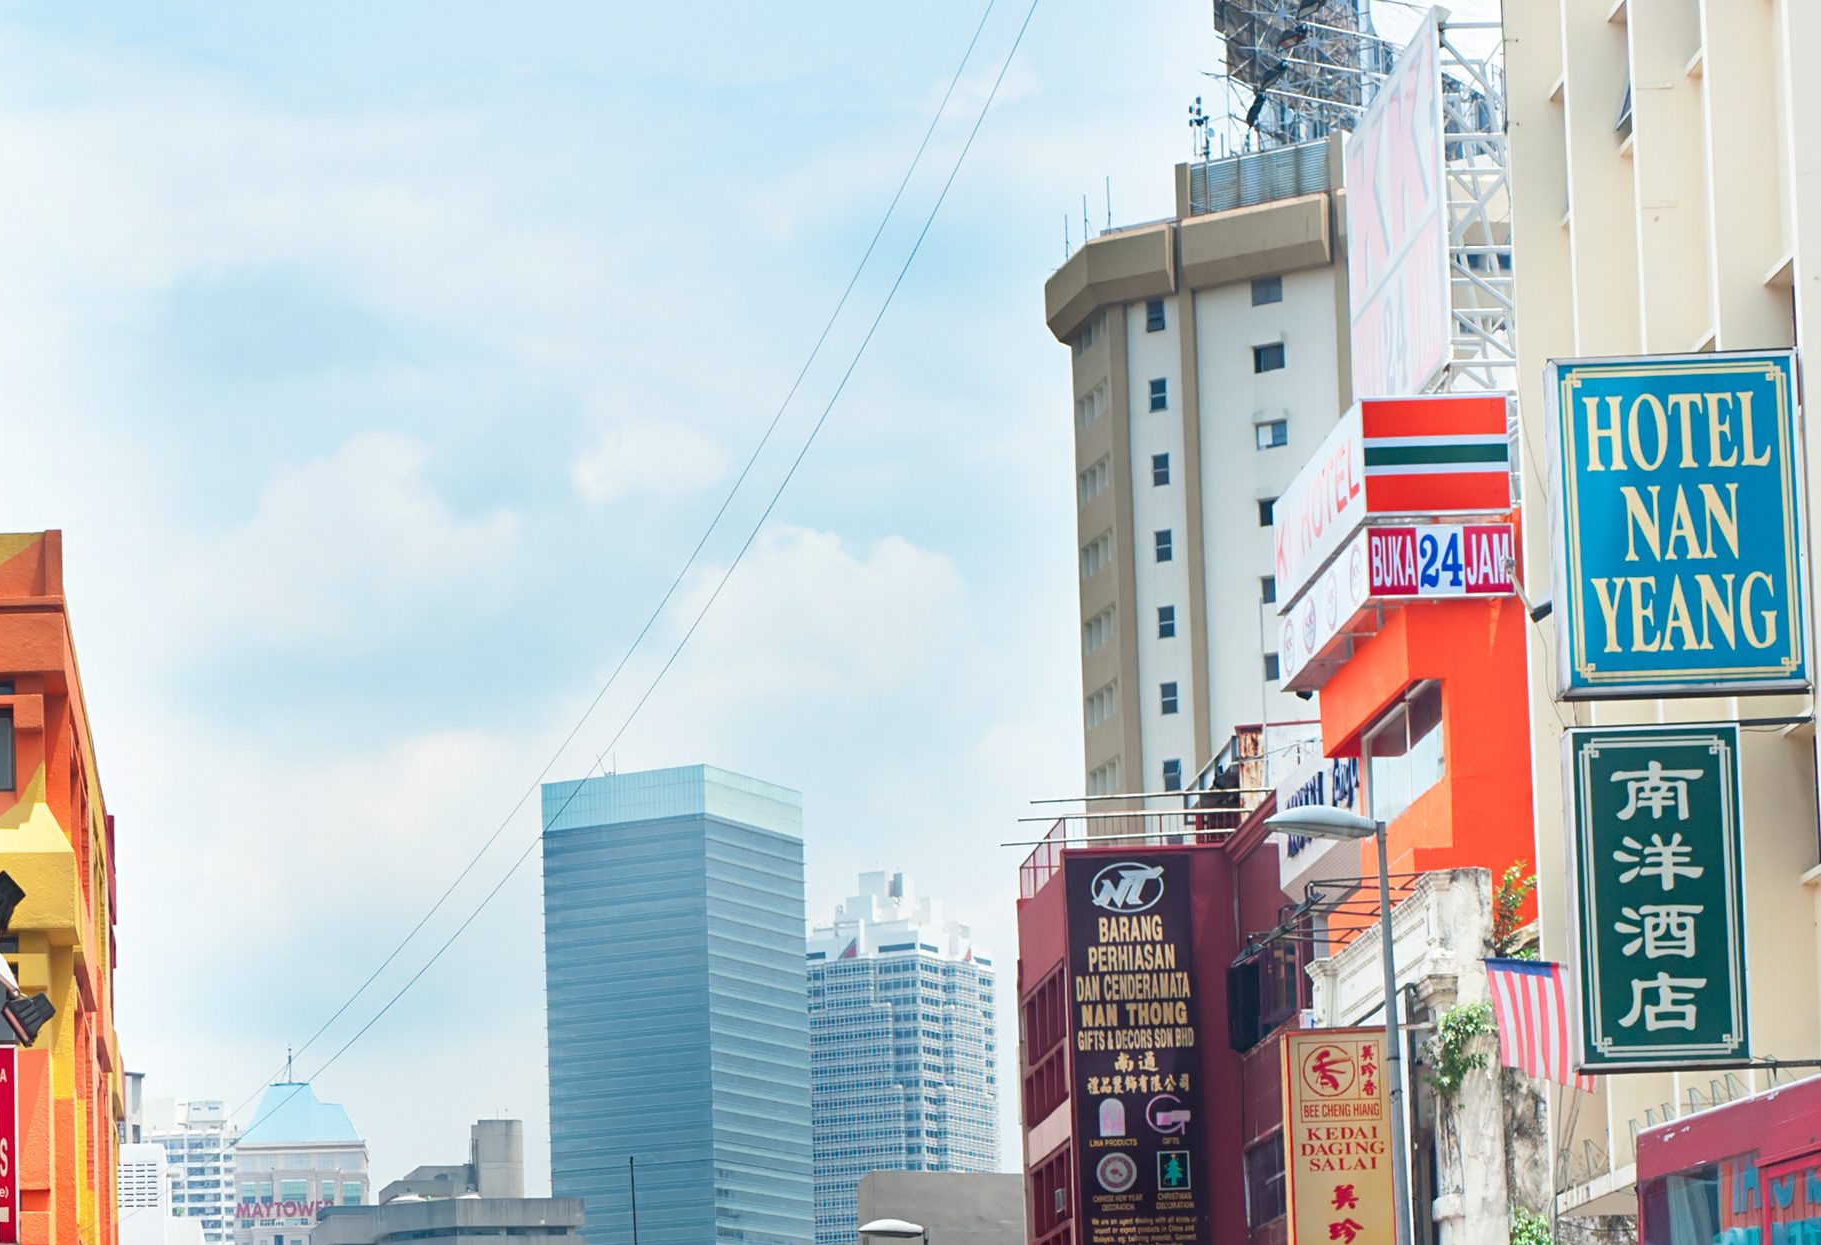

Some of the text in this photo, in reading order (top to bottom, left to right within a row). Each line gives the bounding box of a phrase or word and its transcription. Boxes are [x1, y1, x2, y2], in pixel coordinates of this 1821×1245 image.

[1582, 390, 1771, 472] HOTEL
[1619, 482, 1739, 563] NAN
[1371, 532, 1511, 588] BUKA 24 JAM
[1591, 571, 1777, 655] YEANG
[1609, 761, 1707, 1031] 南洋酒店
[1098, 914, 1164, 943] BARANG
[1088, 944, 1176, 973] PERHIASAN
[1076, 972, 1191, 1001] DAN CENDERAMATA
[1081, 1001, 1188, 1027] NAN THONG
[1078, 1027, 1195, 1051] GIFTS & DECORS SDN BHD
[1303, 1102, 1380, 1118] BEE CHENG HIANG
[1104, 1138, 1138, 1147] PRODUCTS
[1306, 1126, 1379, 1141] KEDAI
[1301, 1141, 1385, 1157] DAGING
[1309, 1157, 1378, 1172] SALAI
[1157, 1191, 1192, 1200] CHRISTMAS
